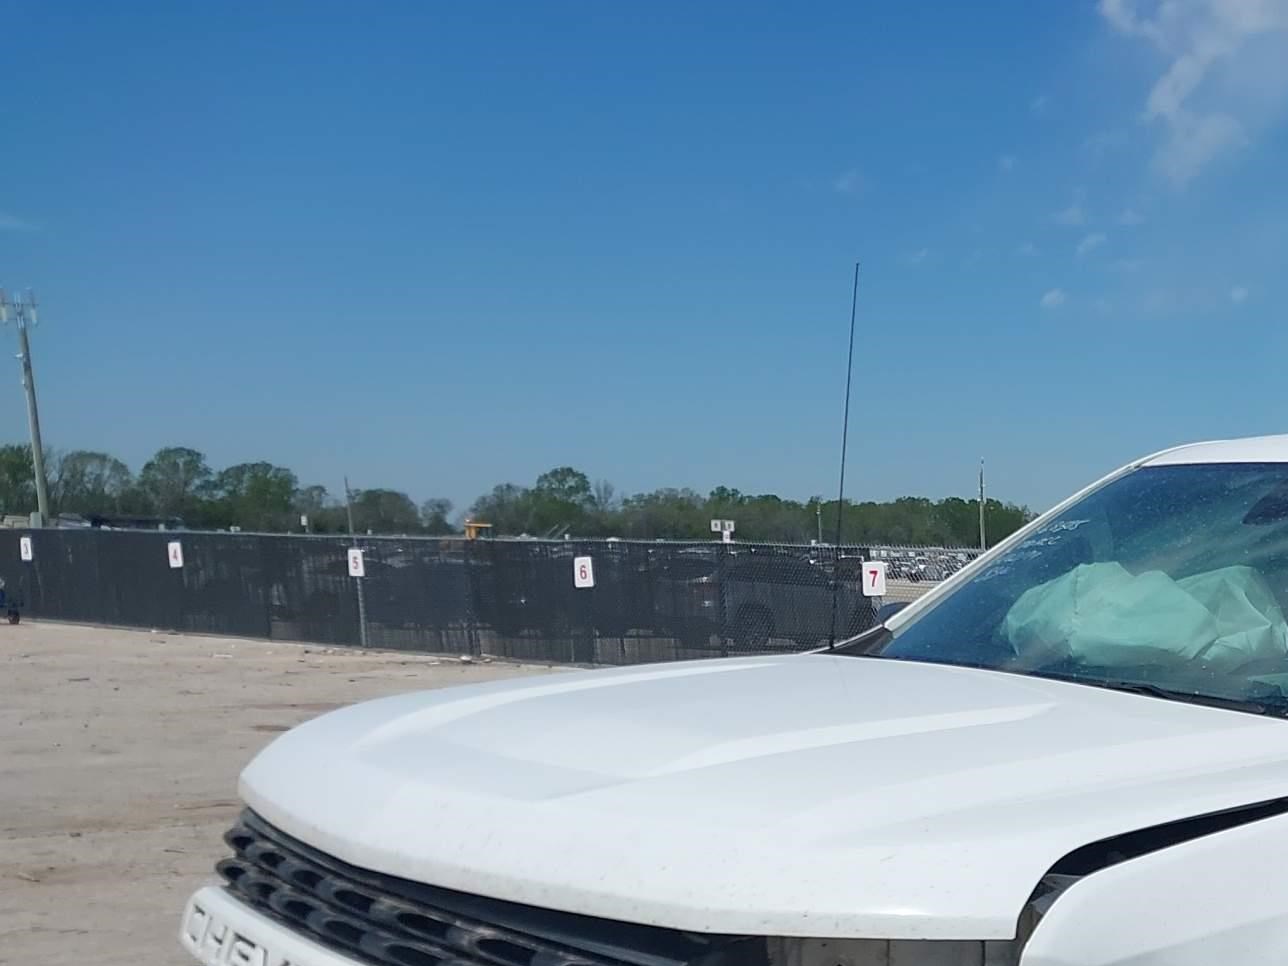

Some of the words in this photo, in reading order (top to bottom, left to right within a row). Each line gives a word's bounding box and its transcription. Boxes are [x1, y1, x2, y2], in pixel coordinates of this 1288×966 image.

[351, 556, 359, 570] 5
[579, 564, 587, 580] 6
[868, 570, 878, 587] 7
